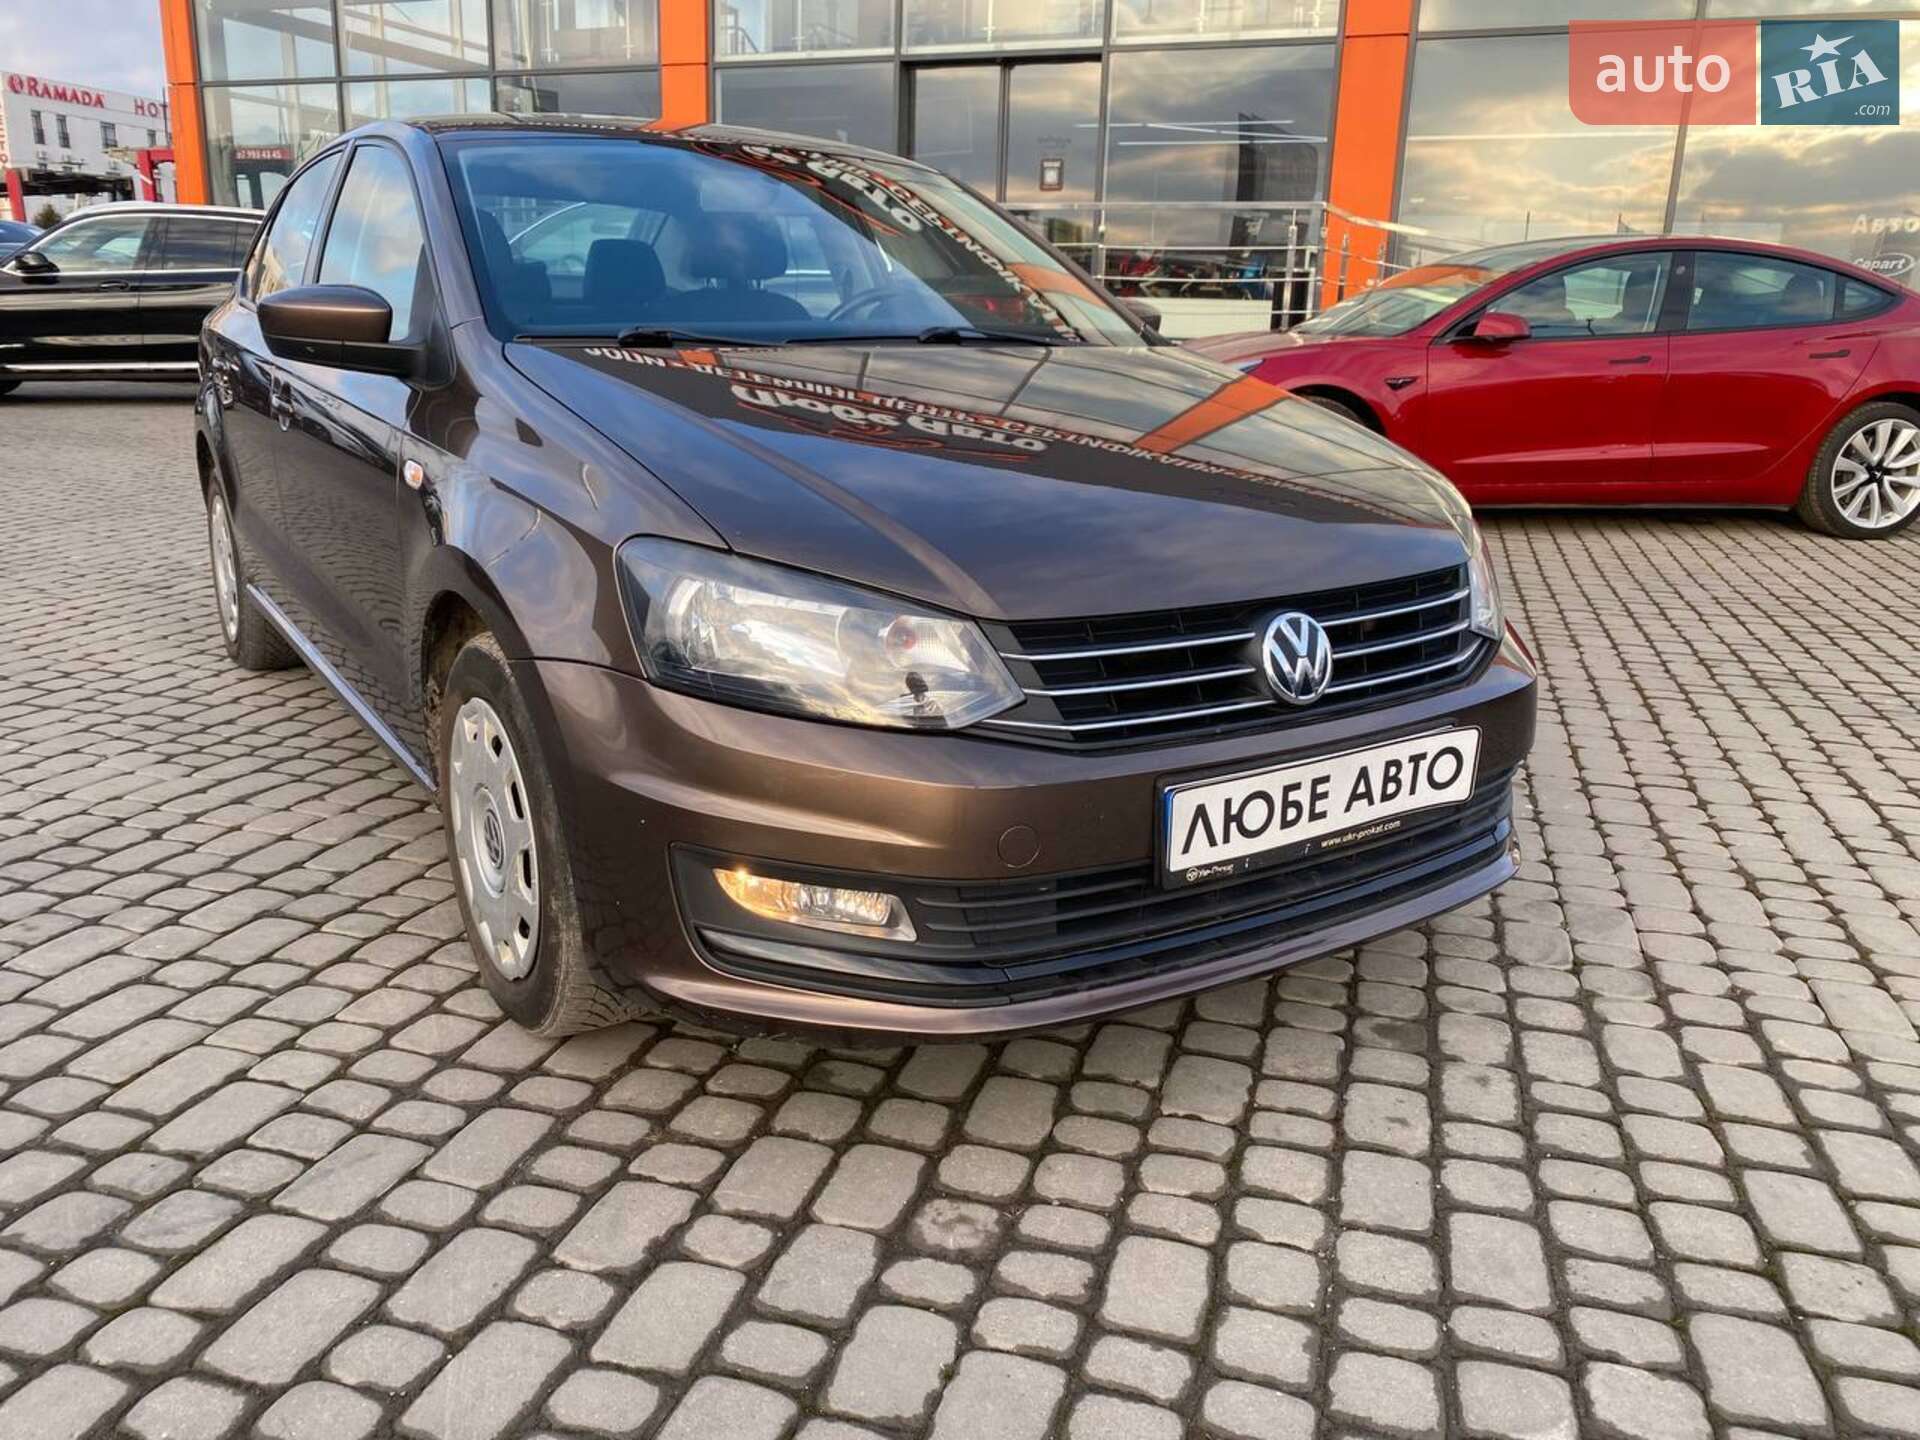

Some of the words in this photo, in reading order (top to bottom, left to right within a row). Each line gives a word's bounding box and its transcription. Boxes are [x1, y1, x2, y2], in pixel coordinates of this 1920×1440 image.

[27, 76, 105, 109] RAMADA
[1181, 774, 1331, 855] ЛЮБЕ
[1344, 746, 1464, 813] АВТО
